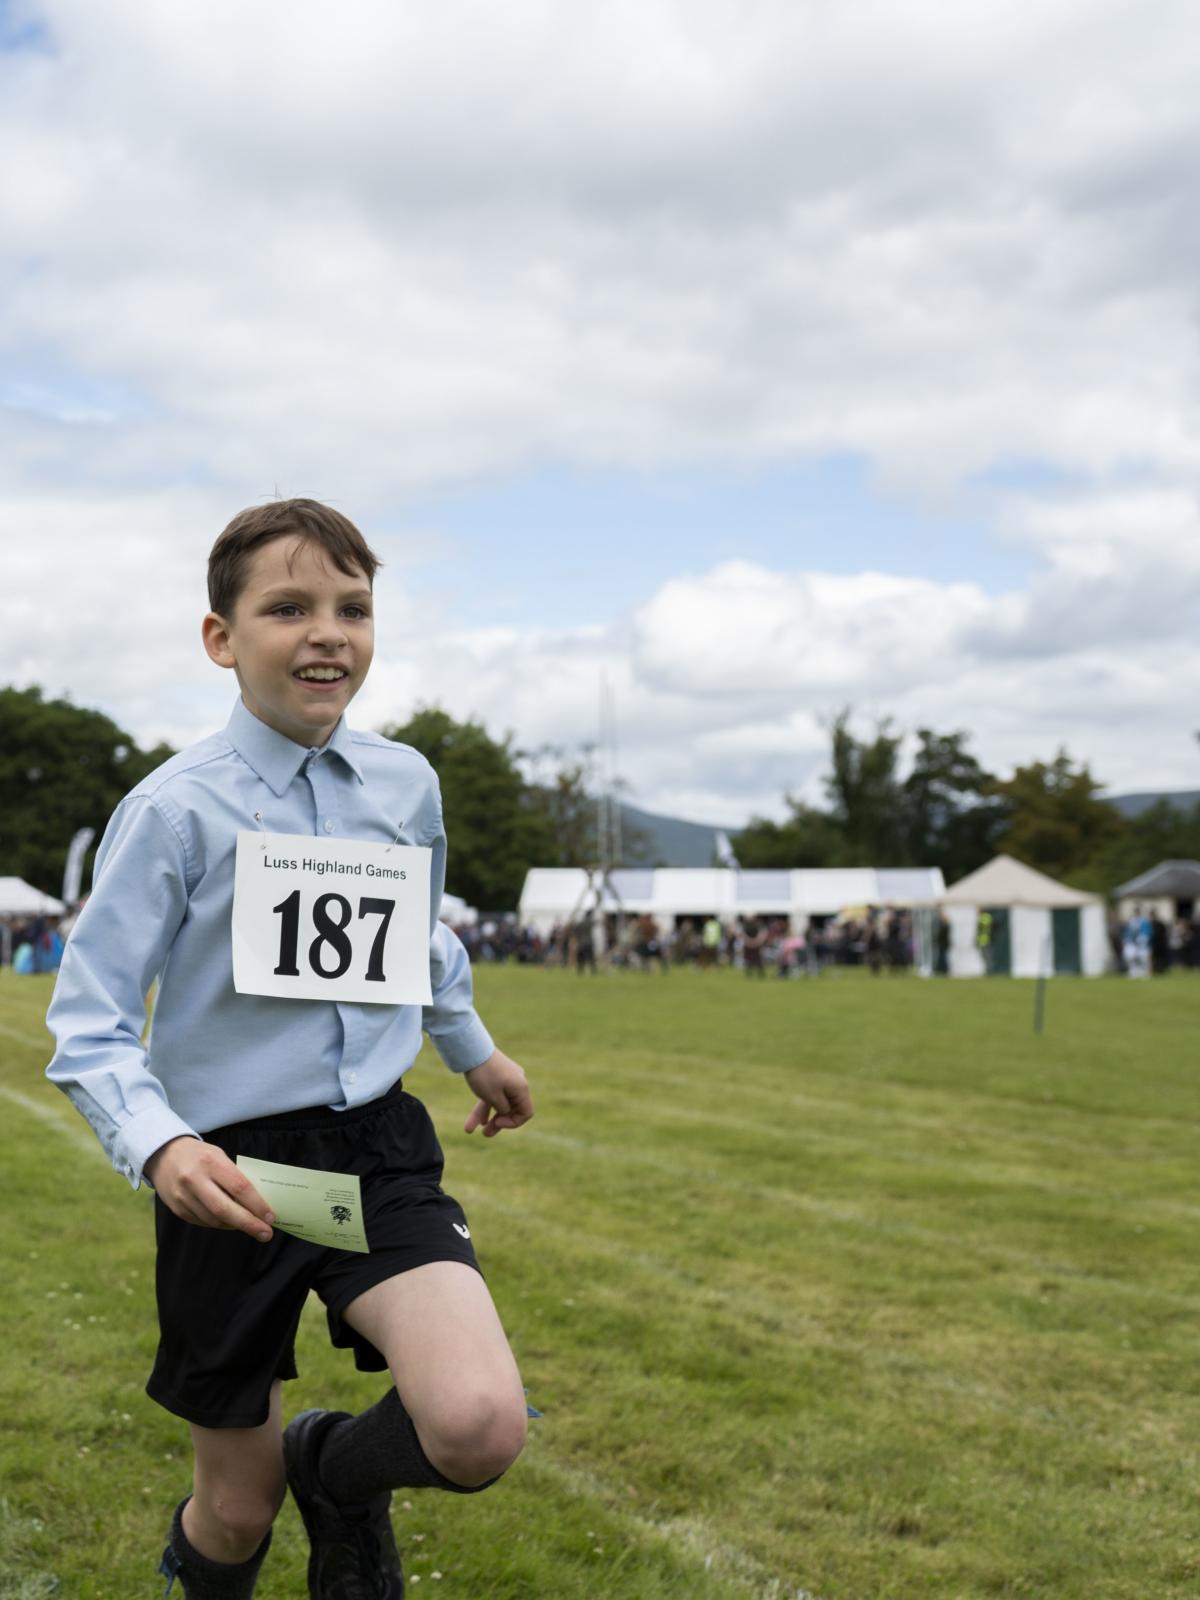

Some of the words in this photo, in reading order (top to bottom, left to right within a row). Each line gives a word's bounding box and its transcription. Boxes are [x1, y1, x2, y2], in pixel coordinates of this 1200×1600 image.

[263, 855, 298, 869] Luss
[302, 858, 362, 875] Highland
[365, 864, 407, 880] Games
[272, 889, 396, 982] 187
